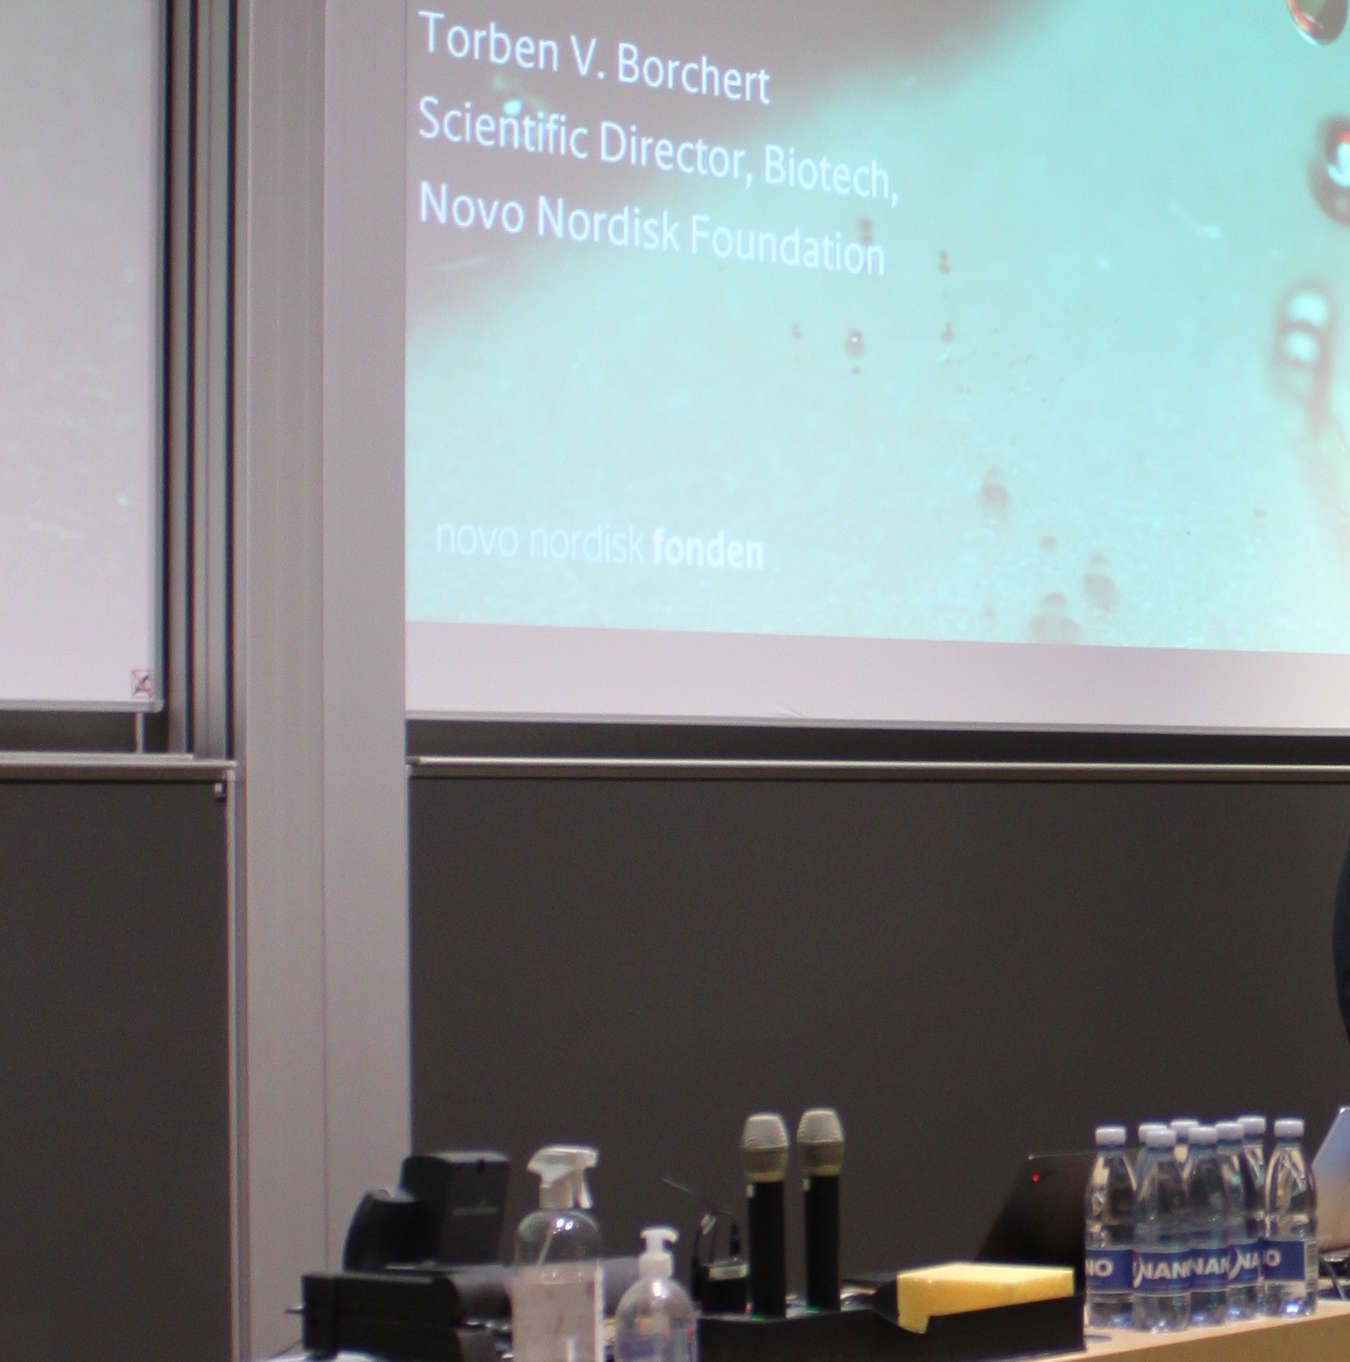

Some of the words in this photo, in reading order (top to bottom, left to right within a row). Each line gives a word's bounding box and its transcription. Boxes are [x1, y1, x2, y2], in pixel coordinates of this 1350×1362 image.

[418, 10, 558, 72] Torben
[570, 35, 605, 80] V.
[617, 41, 771, 105] Borchert
[418, 95, 589, 160] Scientific
[600, 121, 754, 188] Director,
[765, 143, 899, 209] Biotech,
[420, 180, 526, 234] Novo
[537, 195, 682, 252] Nordisk
[691, 214, 886, 276] Foundation
[436, 522, 520, 557] novo
[529, 523, 646, 565] nordisk
[651, 526, 766, 570] fonden
